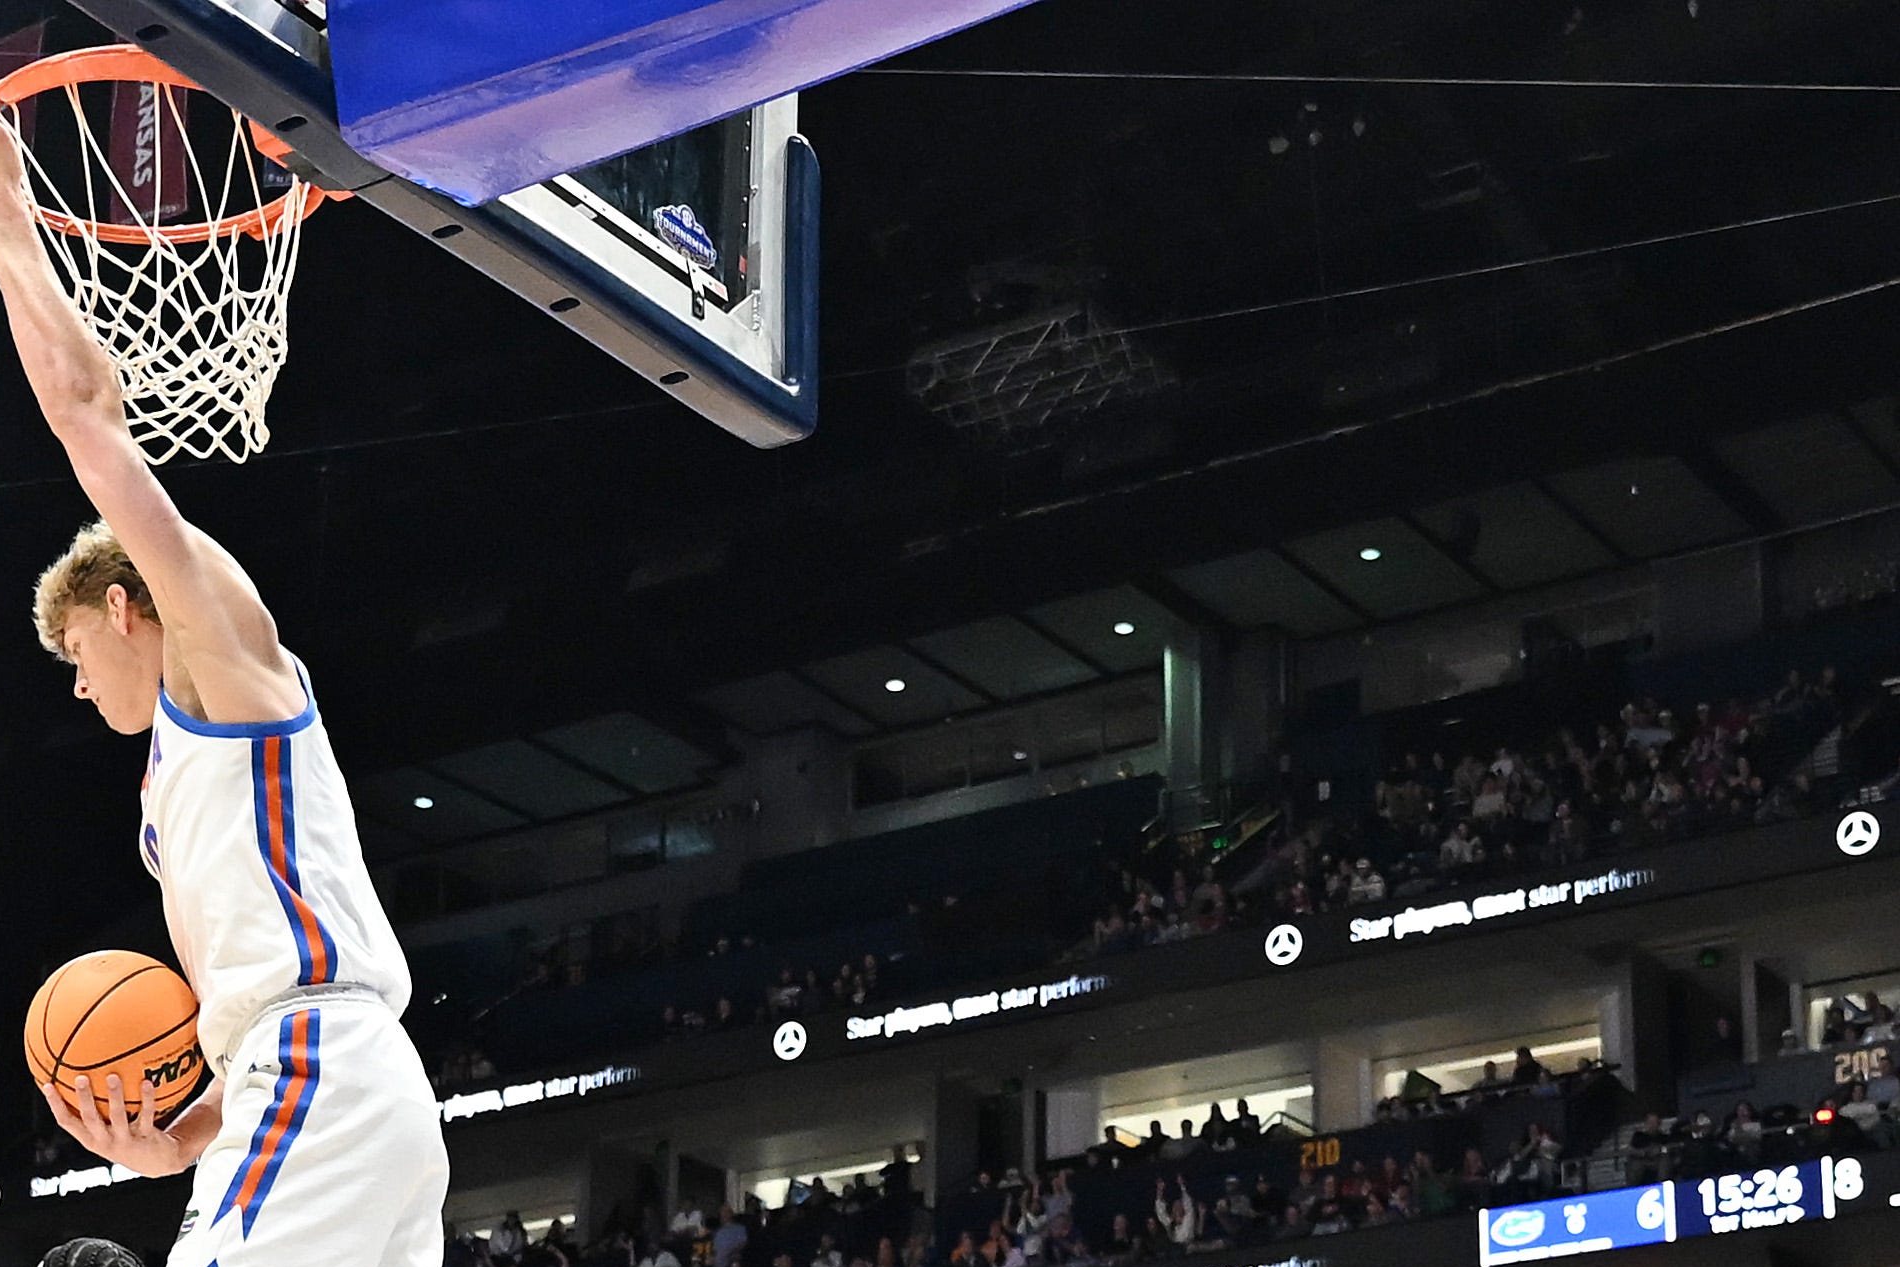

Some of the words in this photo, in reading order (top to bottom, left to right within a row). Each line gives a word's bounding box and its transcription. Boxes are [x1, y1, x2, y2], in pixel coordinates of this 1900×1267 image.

[132, 84, 155, 187] ANSAS
[1528, 882, 1571, 908] star
[1301, 1138, 1340, 1168] 210
[1697, 1165, 1804, 1216] 15:26
[1834, 1158, 1864, 1200] 8
[1636, 1188, 1666, 1230] 6
